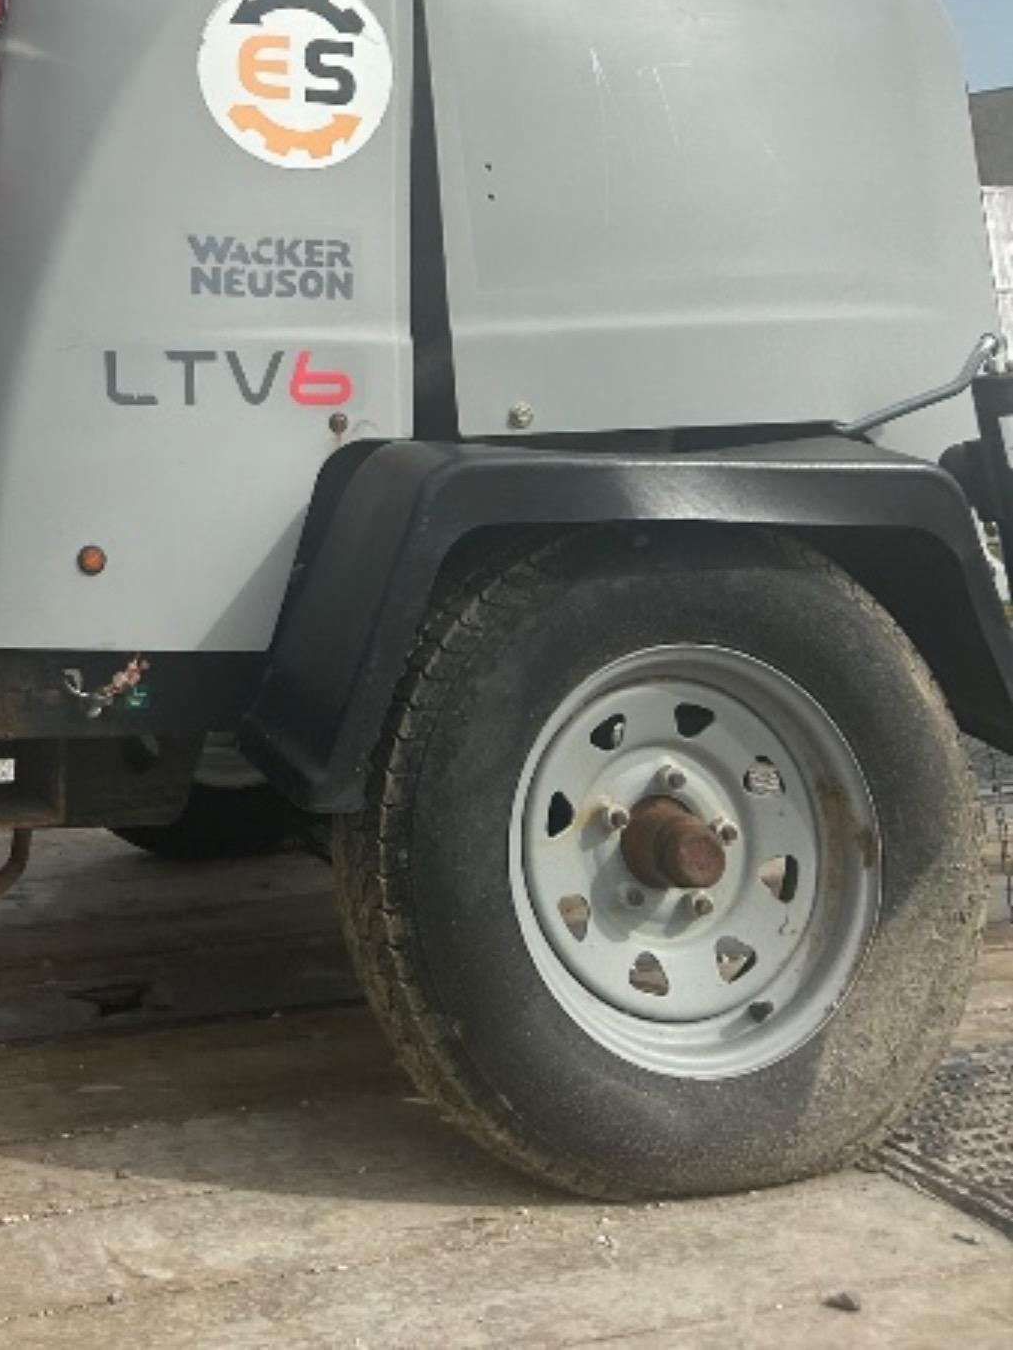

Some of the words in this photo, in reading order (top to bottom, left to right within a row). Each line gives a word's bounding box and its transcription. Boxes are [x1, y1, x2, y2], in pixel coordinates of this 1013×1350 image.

[239, 36, 357, 105] ES
[187, 235, 352, 268] WACKER
[191, 267, 354, 300] NEUSON
[105, 350, 352, 406] LTV6
